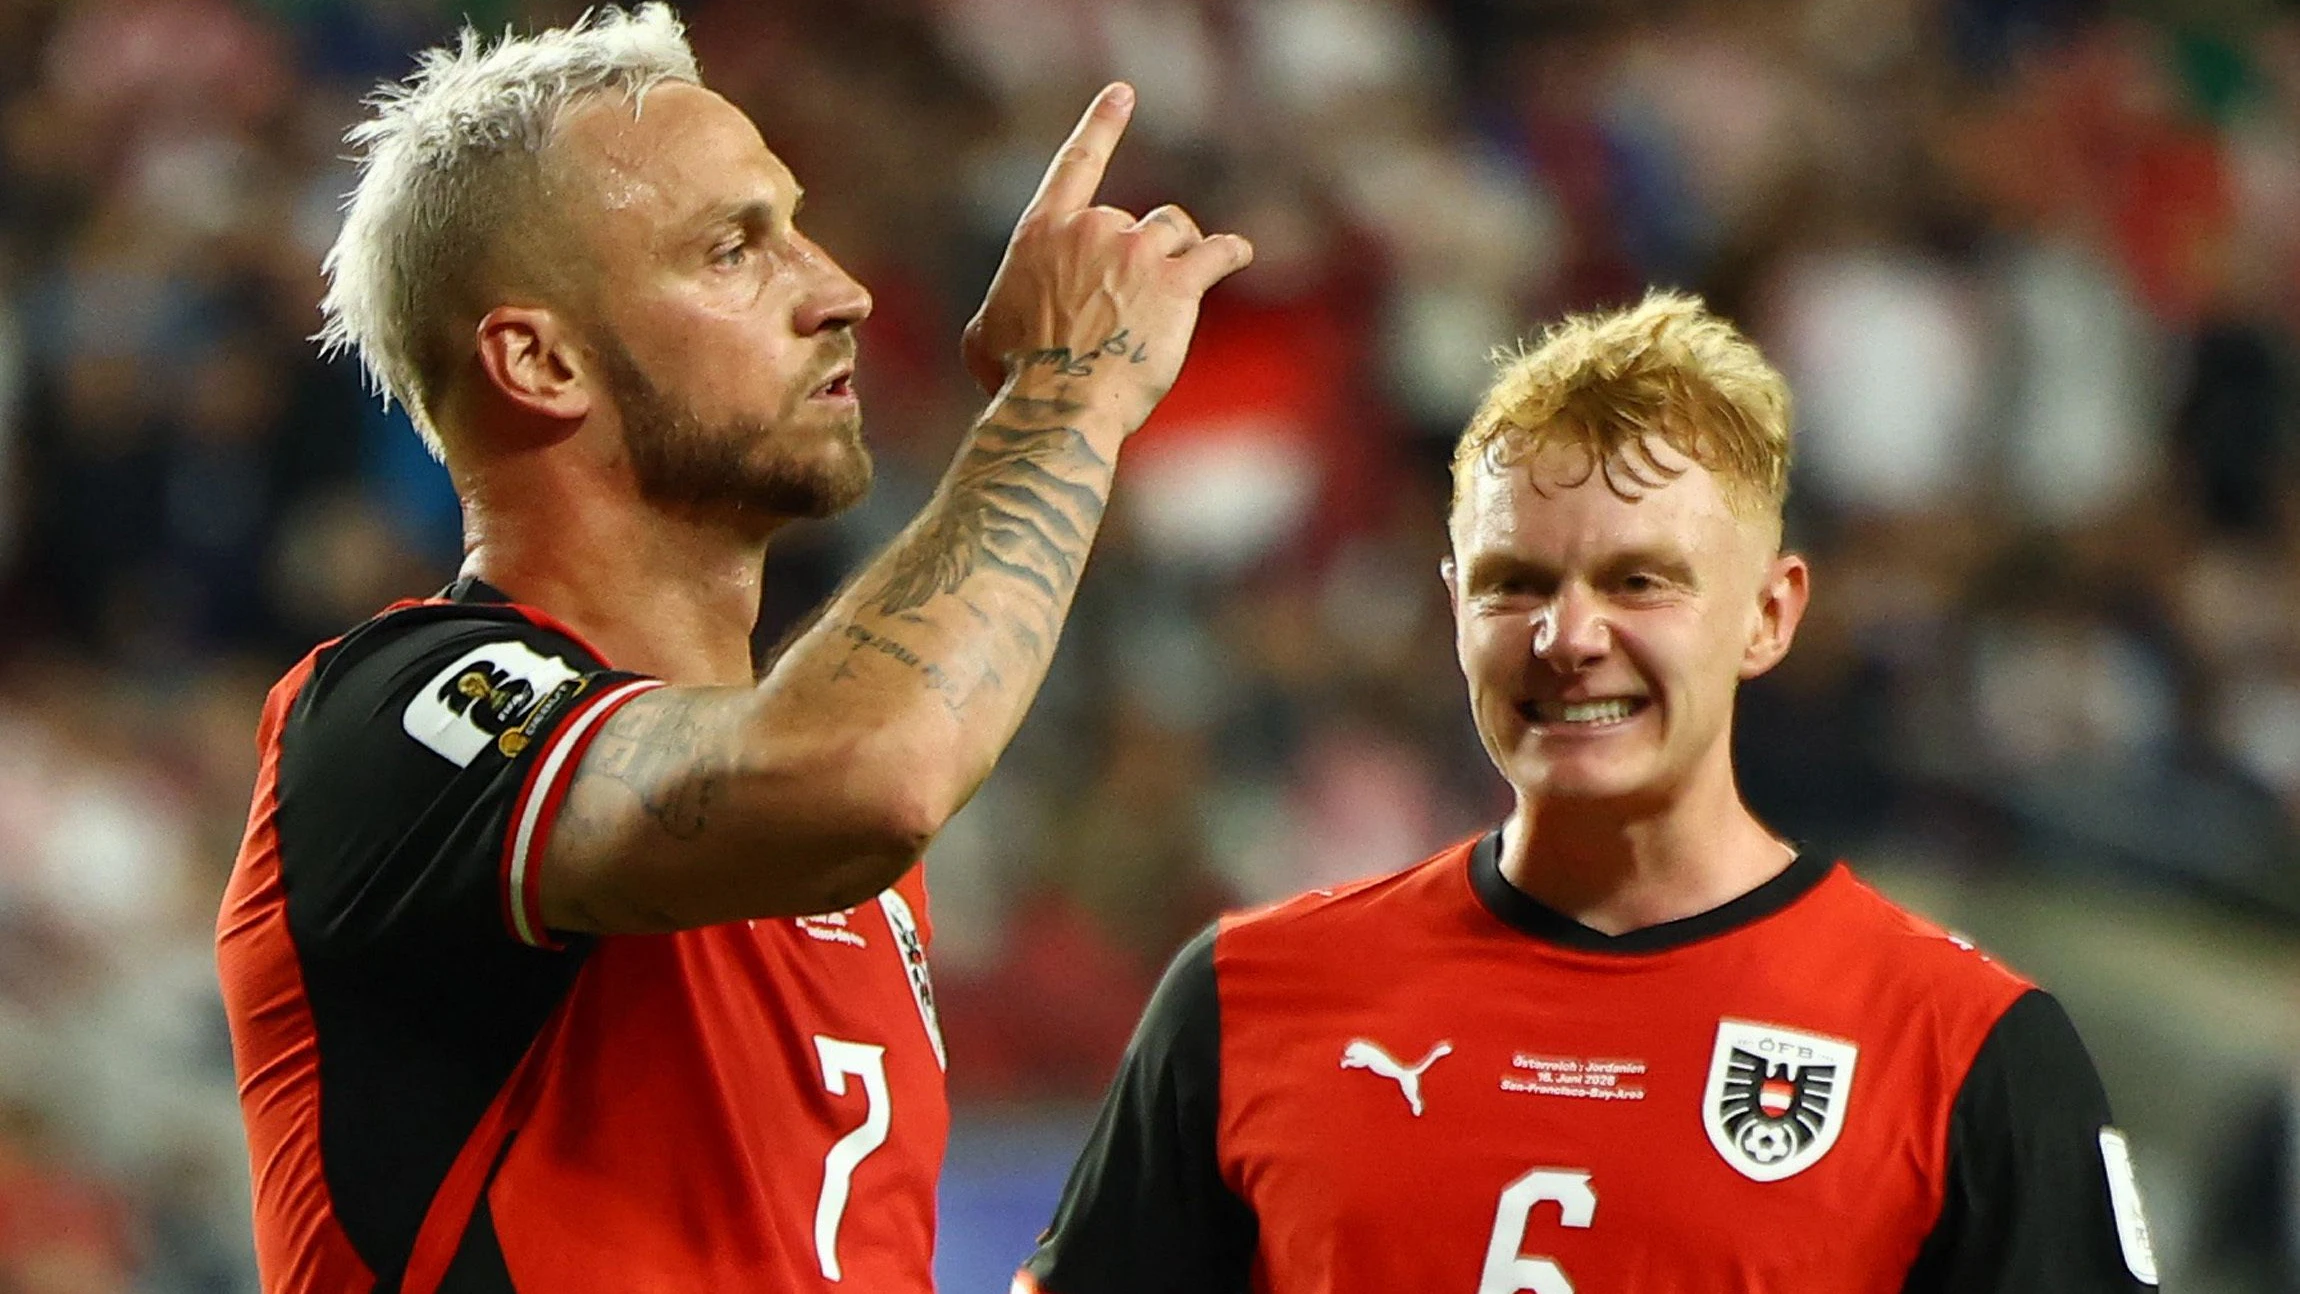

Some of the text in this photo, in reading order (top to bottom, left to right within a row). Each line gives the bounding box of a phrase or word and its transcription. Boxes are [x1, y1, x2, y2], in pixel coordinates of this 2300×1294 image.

[1758, 1037, 1814, 1059] ÖFB
[1512, 1054, 1577, 1072] Österreich
[1585, 1061, 1646, 1074] Jordanien
[1555, 1073, 1583, 1084] Juni
[1500, 1079, 1645, 1100] San-Francisco-Bay-Area
[812, 1035, 892, 1282] 7
[1479, 1167, 1598, 1294] 6
